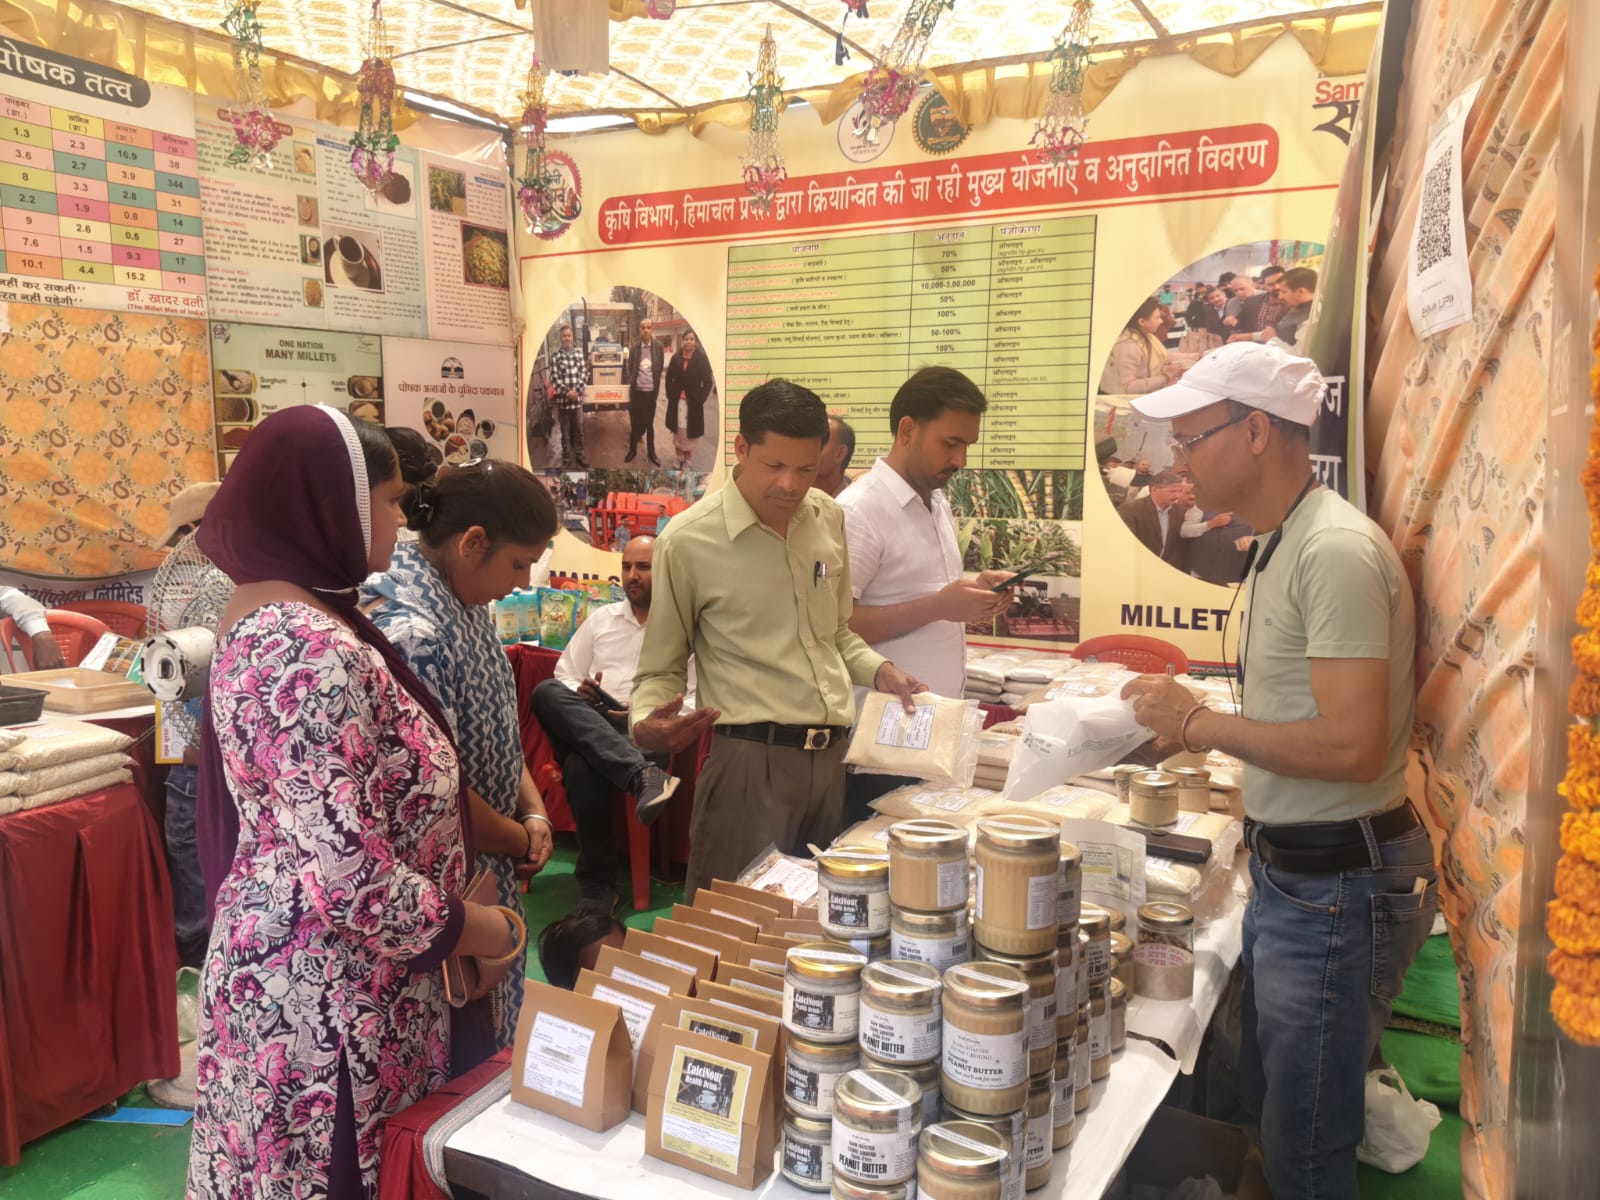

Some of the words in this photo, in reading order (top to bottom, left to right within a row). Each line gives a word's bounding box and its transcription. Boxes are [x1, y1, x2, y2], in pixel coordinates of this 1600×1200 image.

[83, 71, 133, 102] तत्व
[13, 127, 31, 138] 1.3
[70, 140, 86, 150] 2.3
[15, 150, 32, 161] 3.6
[118, 150, 138, 161] 16.9
[71, 161, 87, 171] 2.7
[22, 173, 29, 181] 8
[122, 171, 136, 180] 3.9
[73, 182, 89, 192] 3.3
[168, 179, 184, 189] 344
[604, 200, 631, 240] कृषि
[634, 197, 679, 231] विभाग,
[682, 194, 735, 228] हिमाचल
[775, 191, 804, 222] द्वारा
[807, 174, 879, 215] क्रियान्वित
[882, 168, 906, 205] की
[910, 174, 931, 201] जा
[935, 164, 961, 202] रही
[967, 168, 1005, 207] मुख्य
[1085, 156, 1098, 184] व
[1106, 140, 1192, 191] अनुदानित
[1198, 136, 1269, 174] विवरण
[19, 193, 36, 204] 2.2
[122, 191, 137, 201] 2.8
[75, 203, 90, 213] 1.9
[171, 199, 182, 208] 31
[25, 216, 33, 225] 9
[173, 218, 184, 228] 14
[76, 223, 92, 234] 2.6
[22, 237, 39, 248] 7.6
[174, 238, 185, 247] 27
[78, 245, 93, 254] 1.5
[21, 259, 44, 270] 10.1
[175, 257, 185, 266] 17
[79, 265, 95, 276] 4.4
[126, 272, 145, 281] 15.2
[177, 276, 187, 285] 11
[22, 281, 41, 290] कर
[20, 292, 41, 303] नहीं
[127, 288, 144, 302] डॉ.
[148, 293, 180, 306] खादर
[181, 295, 205, 308] वली
[937, 310, 956, 318] 100%
[931, 329, 961, 337] 50-100%
[279, 339, 294, 350] ONE
[296, 341, 324, 351] NATION
[265, 348, 294, 360] MANY
[296, 350, 337, 363] MILLETS
[398, 381, 421, 393] पोषक
[448, 382, 457, 394] के
[1121, 604, 1228, 631] MILLET
[863, 1032, 880, 1049] PEANUT
[881, 1041, 905, 1054] BUTTER
[948, 1056, 972, 1072] PEANUT
[973, 1067, 1003, 1075] BUTTER
[687, 1062, 724, 1083] CalciNour
[684, 1075, 703, 1087] Health
[703, 1079, 721, 1091] Drink
[839, 1153, 860, 1171] PEANUT
[862, 1162, 888, 1174] BUTTER
